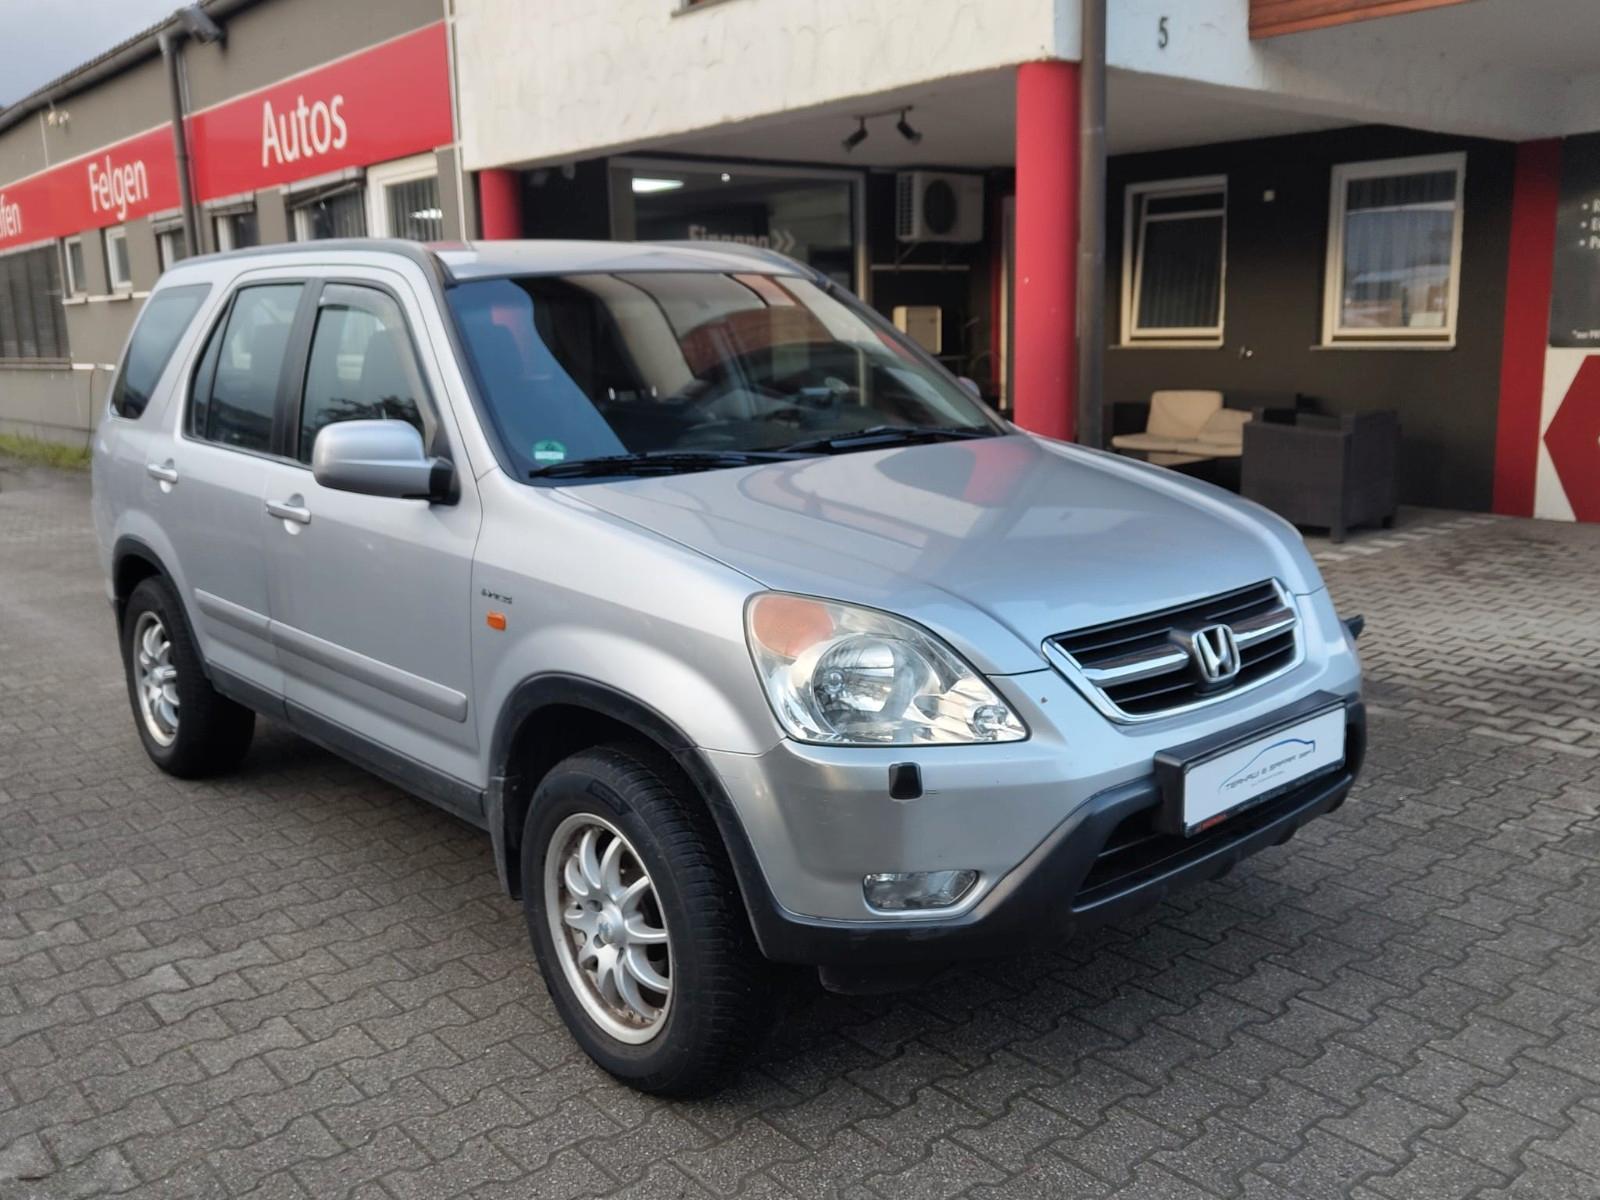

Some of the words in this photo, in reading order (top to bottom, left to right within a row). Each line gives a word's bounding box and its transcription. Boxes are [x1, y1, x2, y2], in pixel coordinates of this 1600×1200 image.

[1158, 16, 1168, 49] 5
[262, 94, 347, 167] Autos
[88, 155, 149, 220] Felgen
